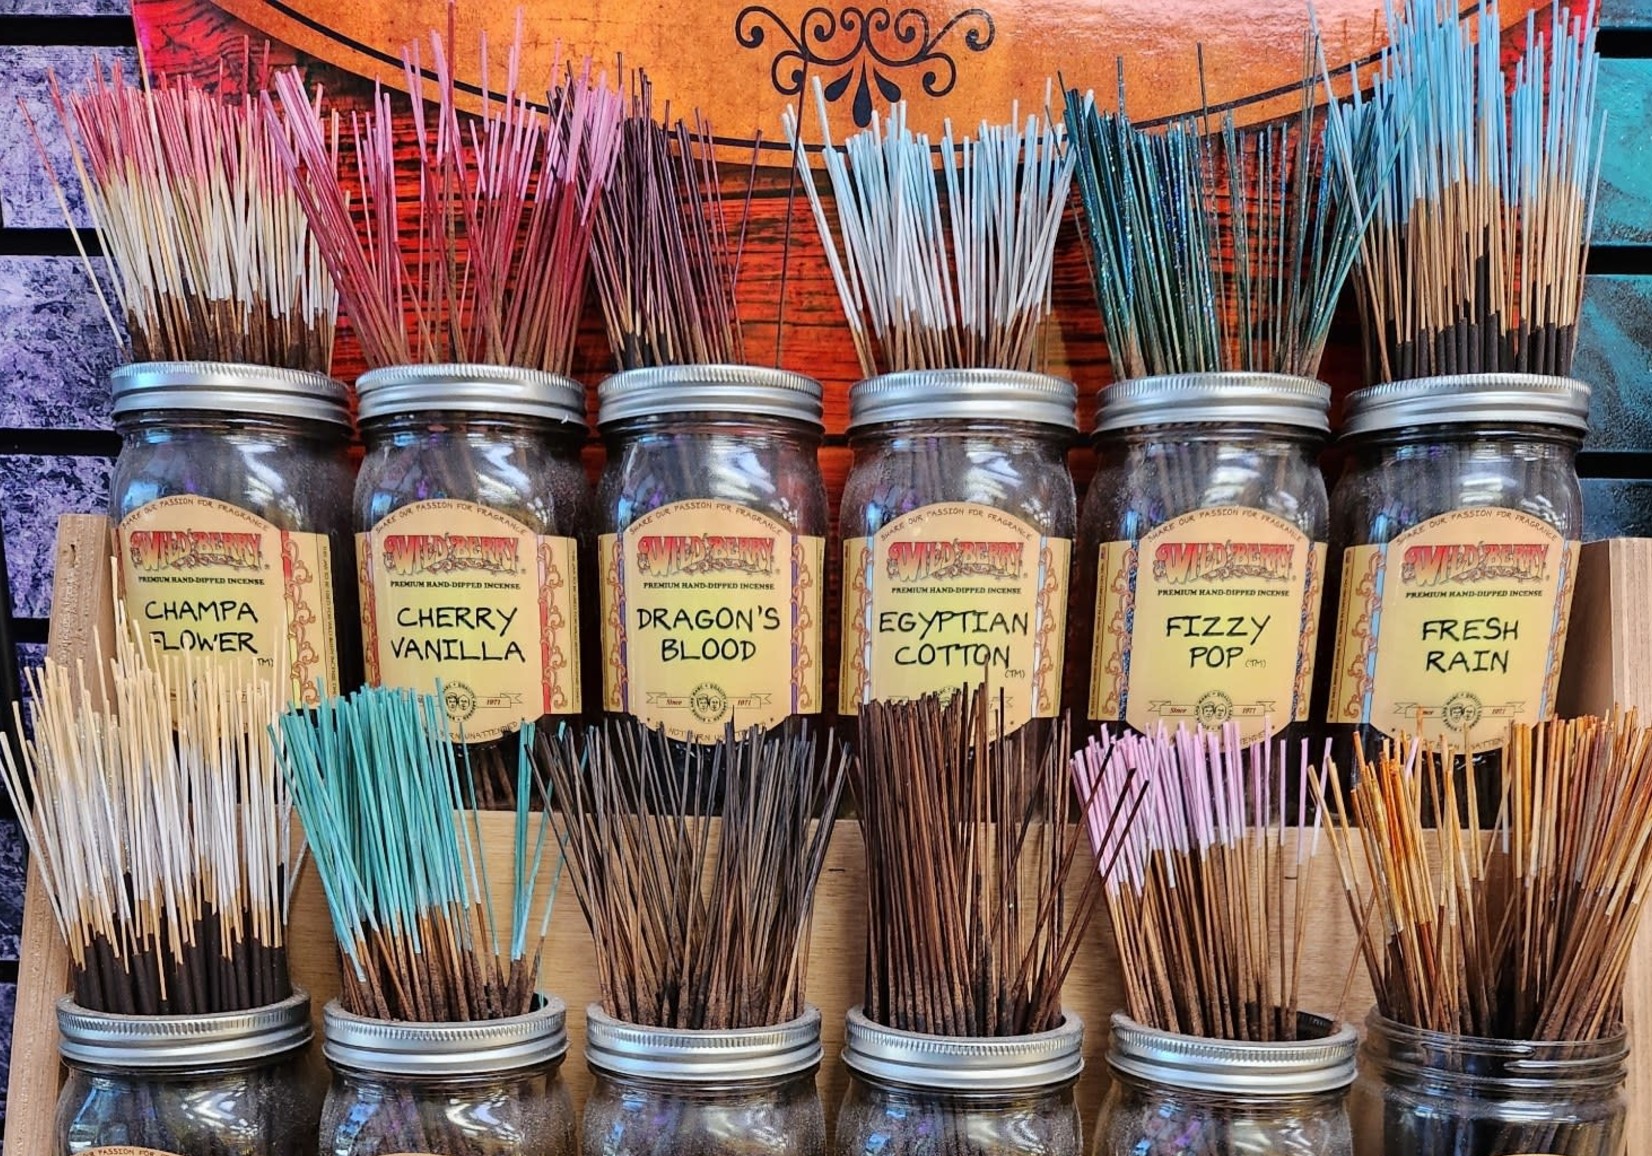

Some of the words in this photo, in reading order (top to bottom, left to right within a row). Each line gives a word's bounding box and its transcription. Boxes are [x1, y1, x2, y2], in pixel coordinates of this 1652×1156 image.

[629, 518, 653, 535] SHARE
[656, 509, 670, 518] OUR
[675, 502, 712, 511] PASSION
[716, 503, 732, 512] FOR
[736, 508, 783, 535] FRAGRANCE
[130, 529, 191, 571] WILD
[191, 531, 262, 571] BERRY
[384, 533, 450, 574] WILD
[450, 536, 519, 574] BERRY
[637, 533, 705, 576] WILD
[707, 536, 775, 576] BERRY
[887, 539, 958, 582] WILD
[958, 542, 1024, 580] BERRY
[1153, 541, 1230, 584] WILD
[1231, 543, 1294, 581] BERRY
[1402, 542, 1482, 586] WILD
[1483, 544, 1549, 584] BERRY
[145, 601, 258, 622] CHAMPA
[397, 607, 517, 636] CHERRY
[637, 606, 780, 632] DRAGON'S
[880, 611, 1028, 640] EGYPTIAN
[1166, 615, 1270, 645] FIZZY
[1422, 617, 1519, 641] FRESH
[391, 637, 525, 662] VANILLA
[662, 638, 756, 662] BLOOD
[895, 644, 1010, 669] COTTON
[1190, 646, 1243, 669] POP
[1426, 650, 1509, 674] RAIN
